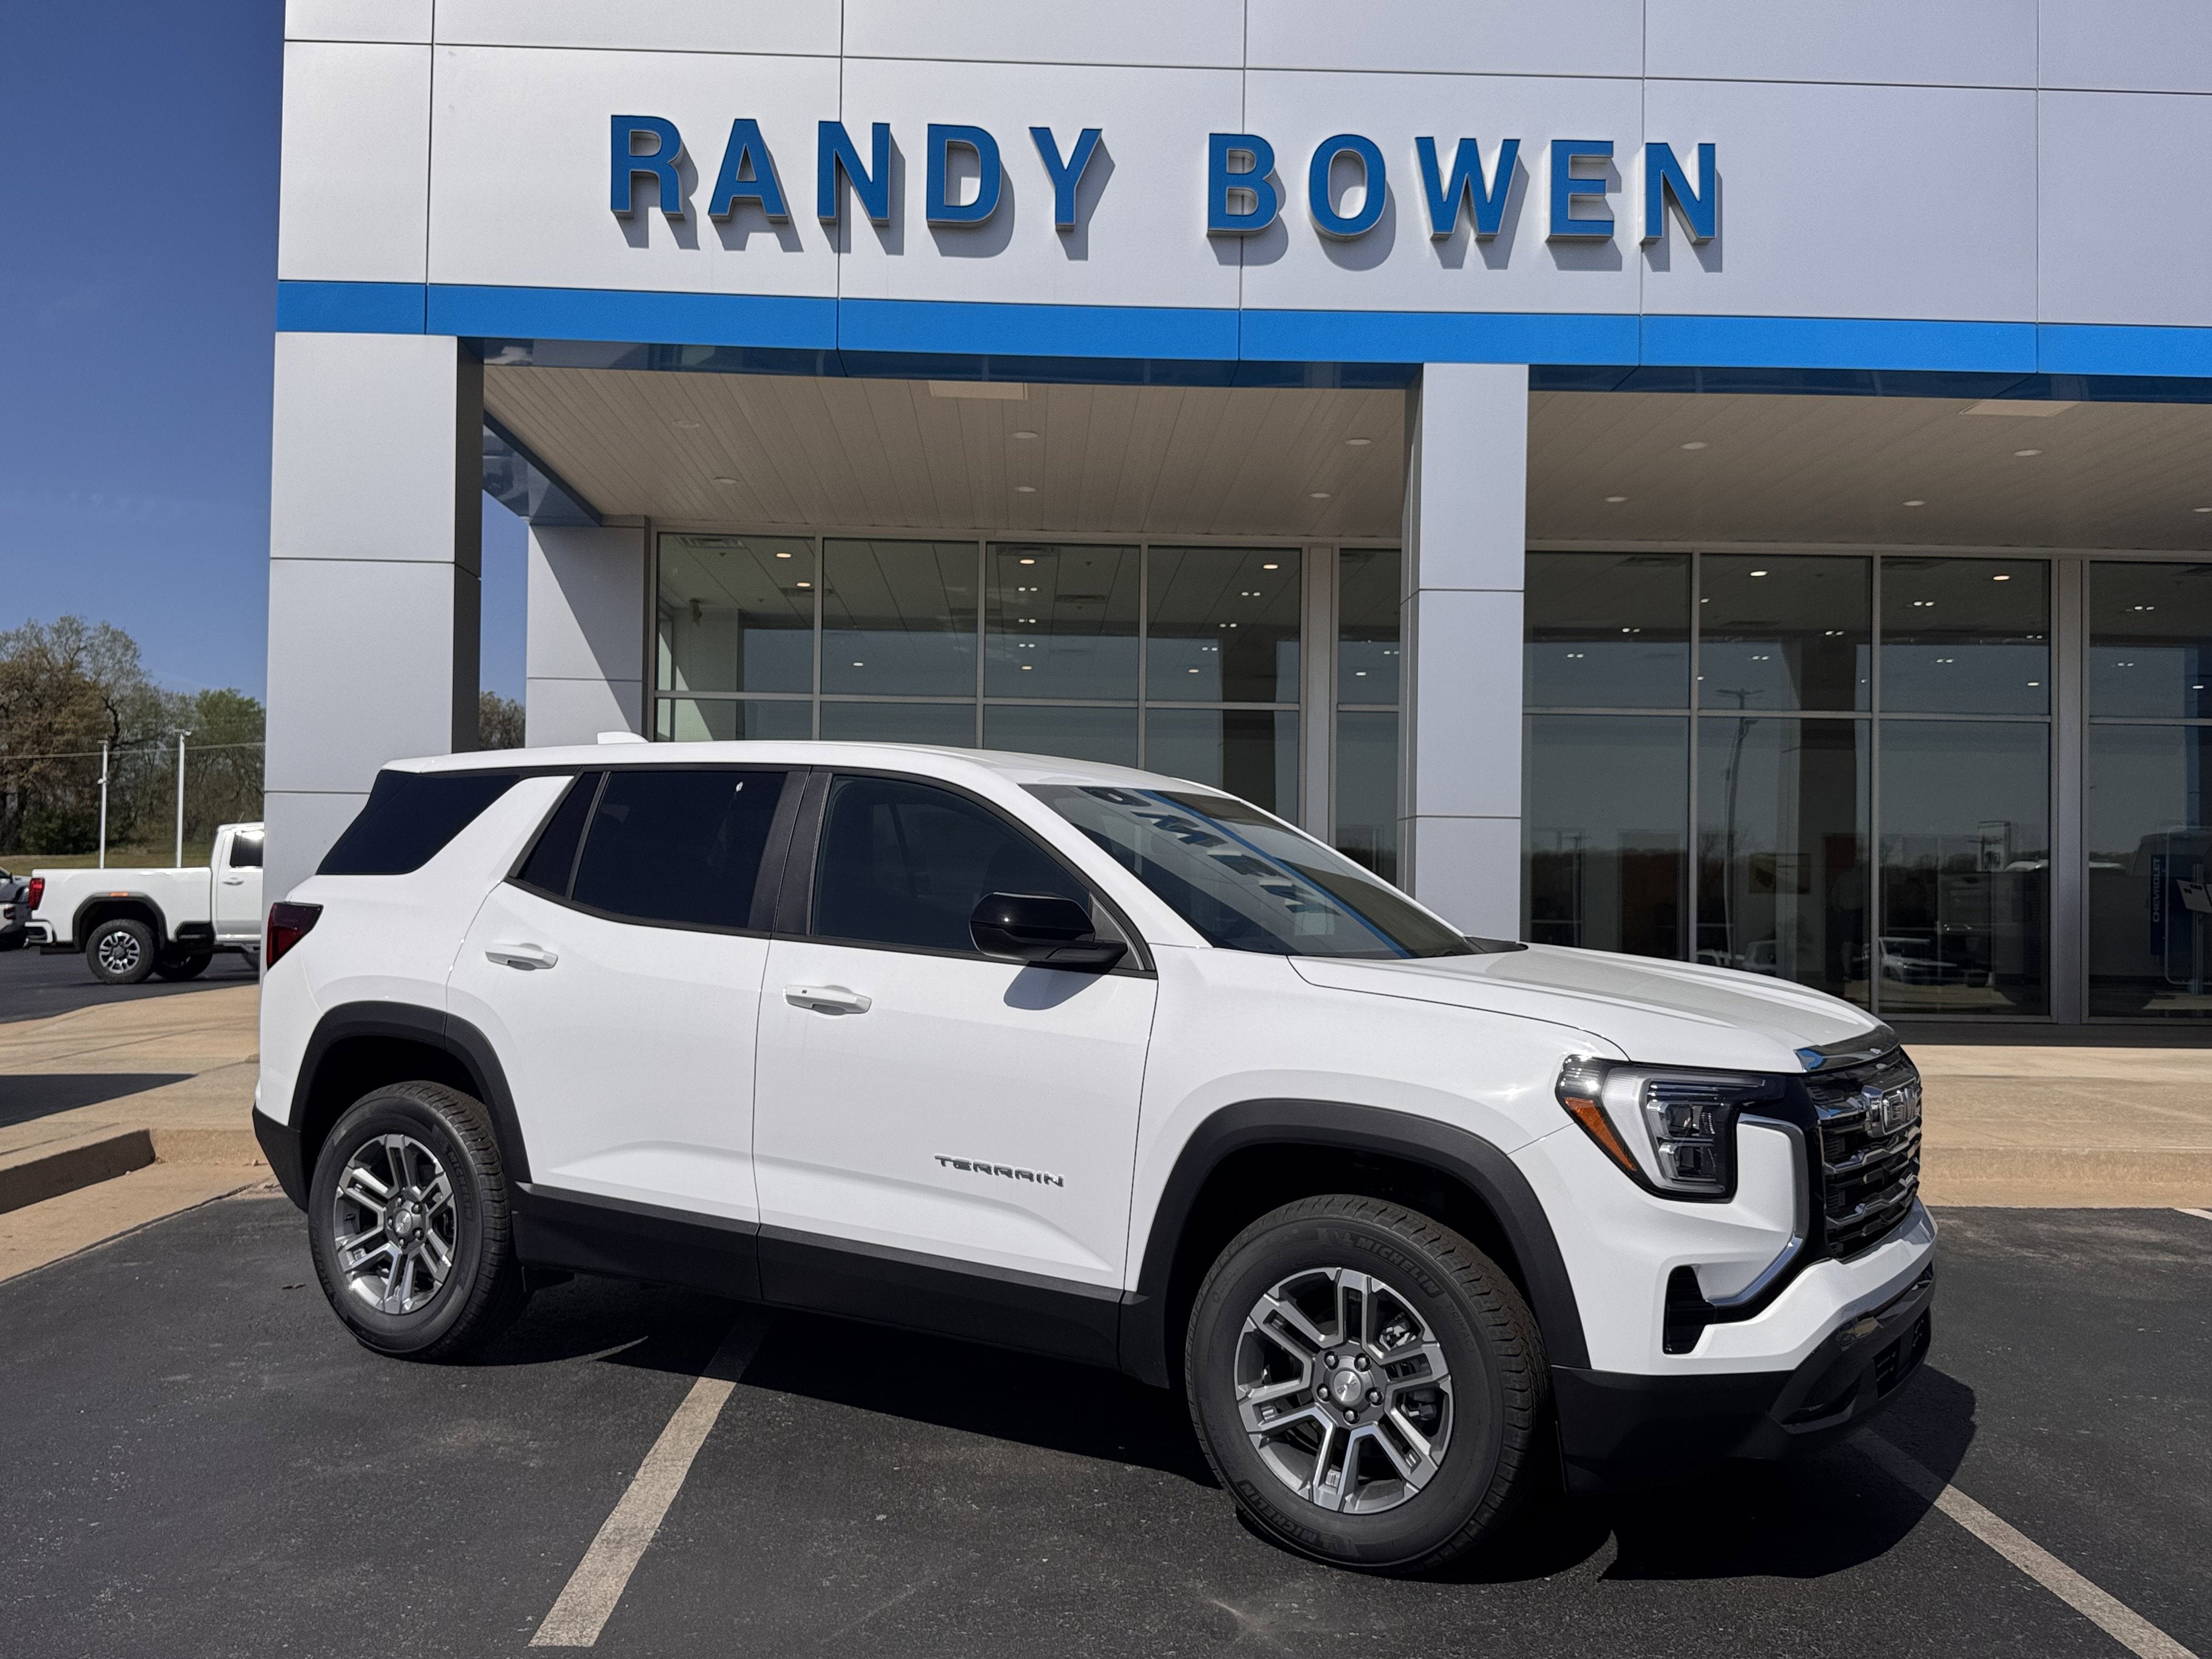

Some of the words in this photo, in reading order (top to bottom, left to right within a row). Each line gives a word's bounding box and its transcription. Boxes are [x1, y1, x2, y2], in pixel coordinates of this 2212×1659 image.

[611, 115, 1102, 231] RANDY
[1207, 133, 1716, 244] BOWEN
[934, 1154, 1064, 1187] TERRAIN
[1356, 1238, 1440, 1295] MICHELIN
